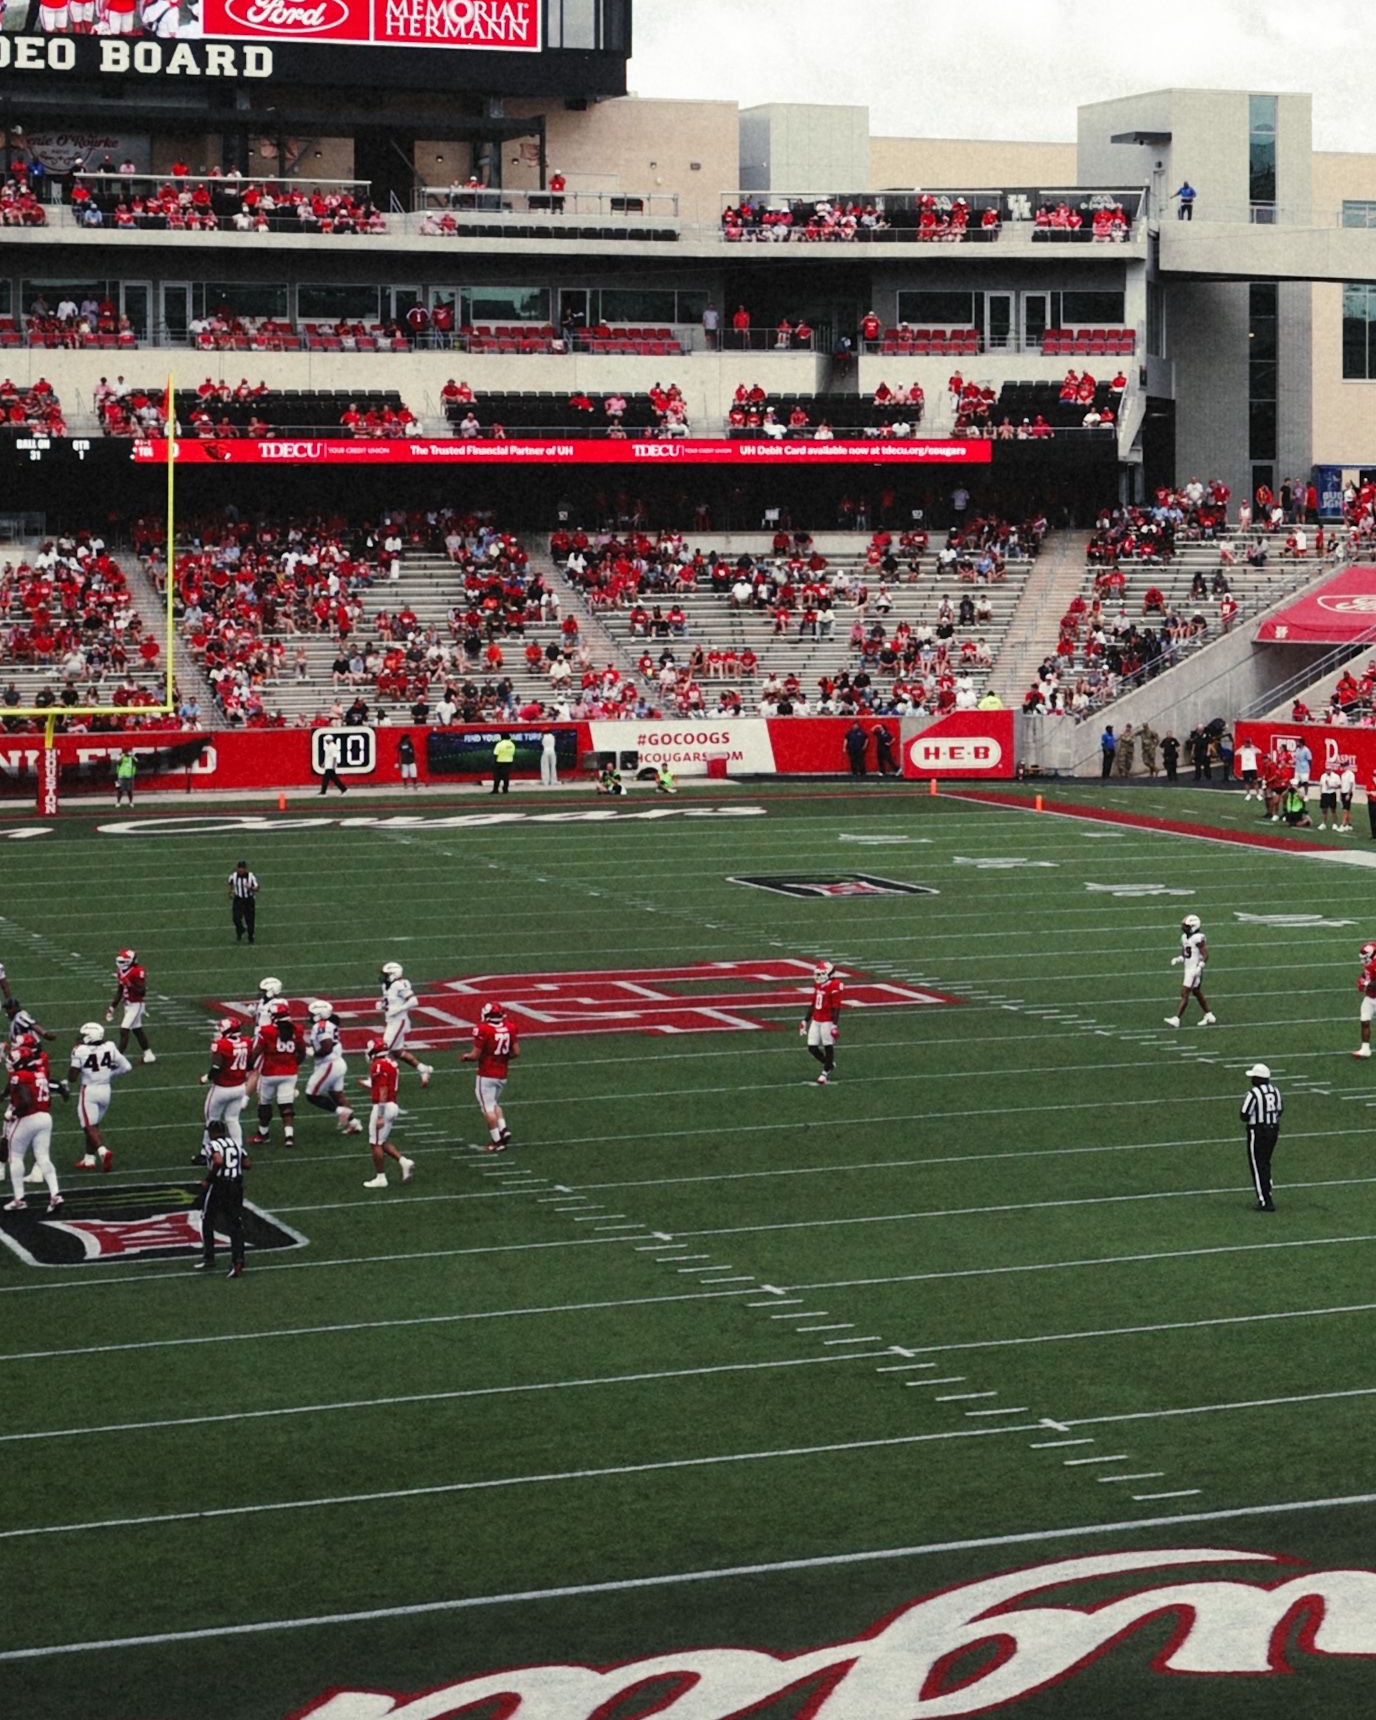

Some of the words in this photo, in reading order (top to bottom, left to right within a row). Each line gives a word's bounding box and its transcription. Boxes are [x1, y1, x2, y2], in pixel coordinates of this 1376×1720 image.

[386, 14, 528, 41] HERMANN
[100, 39, 274, 78] BOARD
[258, 442, 322, 458] TDECU
[411, 445, 428, 455] The
[431, 445, 463, 455] Trusted
[467, 445, 509, 455] Financial
[510, 446, 545, 456] Partner
[546, 446, 555, 456] of
[558, 446, 574, 455] UH
[633, 444, 682, 457] TDECU
[740, 446, 755, 455] UH
[758, 446, 782, 455] Debit
[785, 446, 806, 455] Card
[808, 446, 846, 455] available
[849, 448, 868, 456] now
[871, 447, 880, 456] at
[883, 446, 967, 458] tdecu.org/cougars
[637, 732, 730, 747] #GOCOOGS
[84, 1051, 112, 1072] 44
